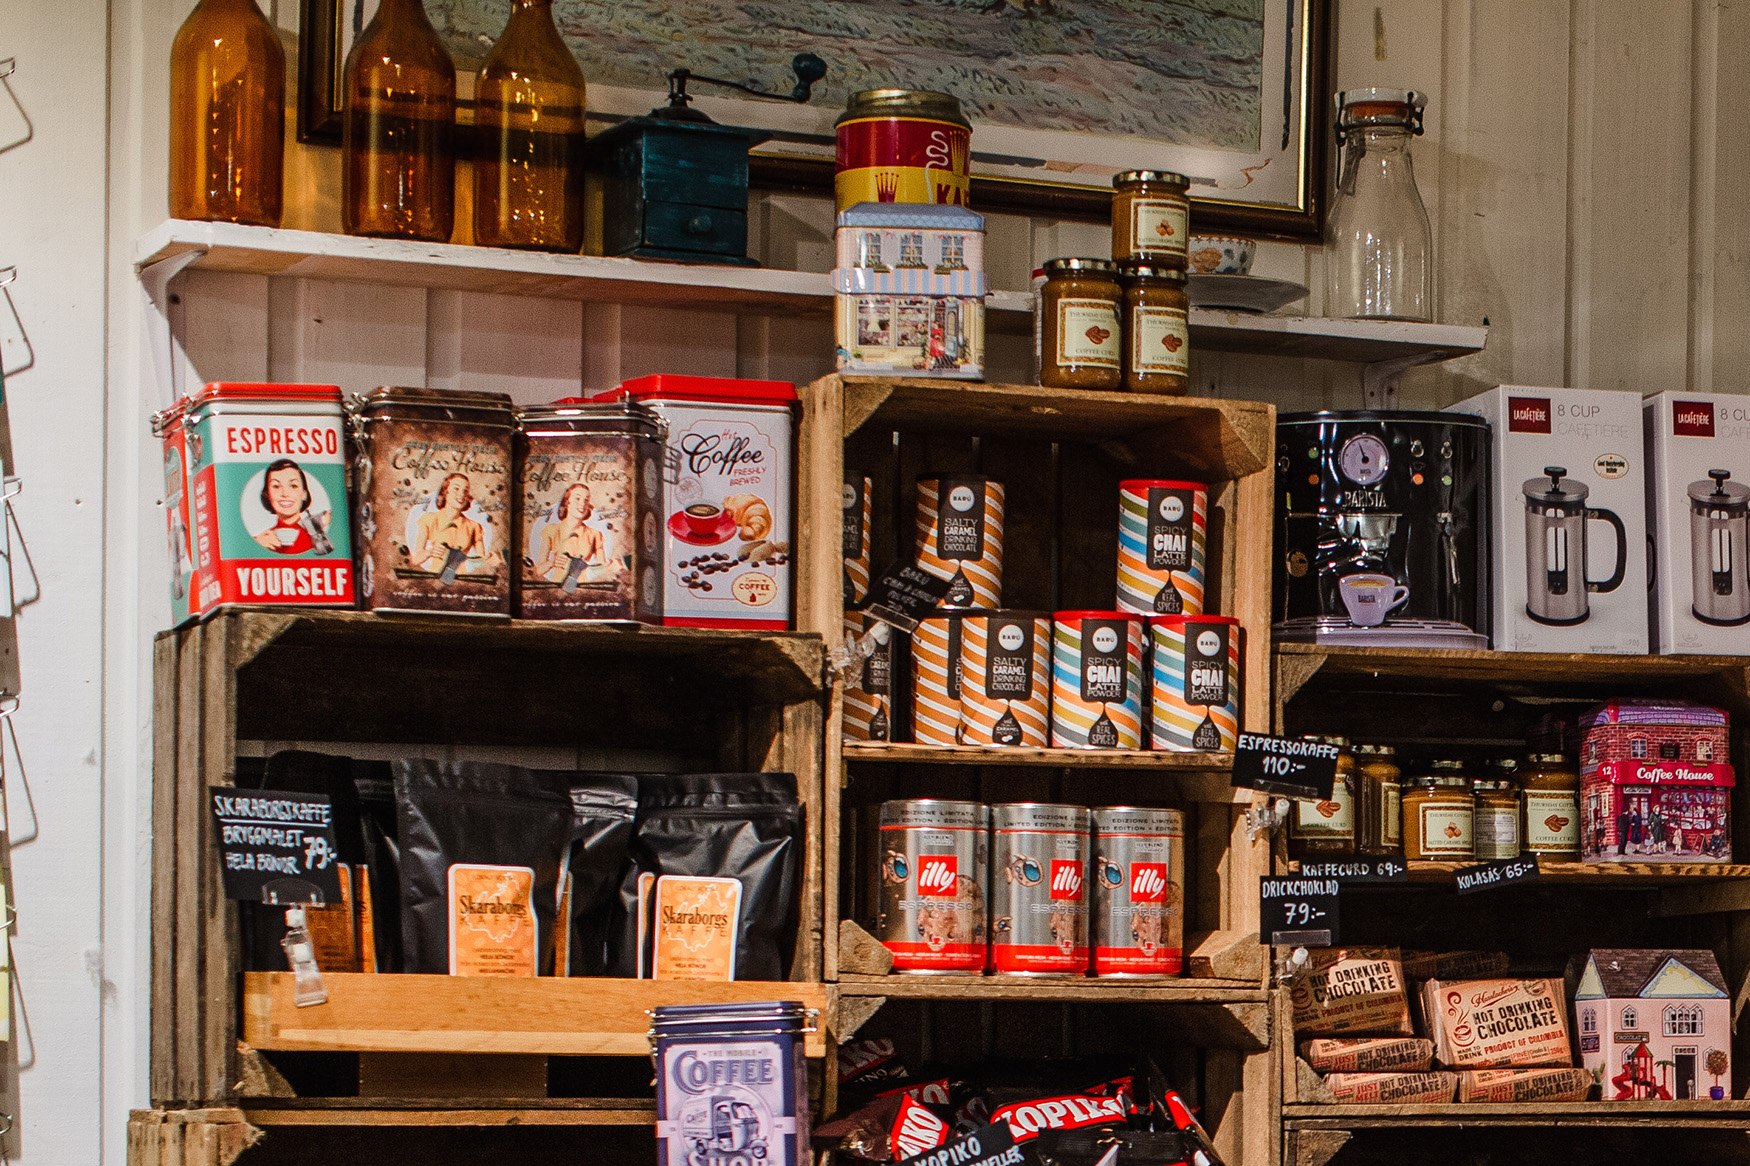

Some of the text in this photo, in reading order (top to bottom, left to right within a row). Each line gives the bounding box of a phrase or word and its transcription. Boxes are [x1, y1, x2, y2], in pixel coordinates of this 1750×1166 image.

[1557, 404, 1600, 419] 8 CUP
[1720, 408, 1729, 421] 8
[227, 427, 338, 455] ESPRESSO
[681, 433, 764, 478] Coffee
[392, 446, 448, 480] Coffee
[571, 462, 627, 483] House
[734, 466, 767, 477] FRESHLY
[729, 477, 761, 487] BREWED
[1342, 490, 1388, 508] BARISTA
[944, 518, 978, 528] SALTY
[1154, 525, 1187, 534] SPICY
[943, 527, 977, 537] CARAMEL
[943, 536, 977, 544] DRINKING
[1153, 534, 1187, 551] CHAI
[943, 544, 977, 552] CHOCOLATE
[1154, 551, 1187, 560] LATTE
[236, 567, 347, 597] YOURSELF
[738, 583, 770, 591] COFFEE
[1156, 602, 1180, 612] SPICES
[993, 657, 1027, 666] SALTY
[1087, 657, 1122, 666] SPICY
[1191, 660, 1224, 670] SPICY
[992, 666, 1027, 676] CARAMEL
[1086, 665, 1121, 684] CHAI
[1190, 669, 1224, 687] CHAI
[992, 675, 1026, 683] DRINKING
[992, 683, 1026, 692] CHOCOLATE
[1087, 683, 1121, 691] LATTE
[1087, 690, 1121, 698] POWDER
[1192, 686, 1224, 694] LATTE
[1191, 693, 1224, 701] POWDER
[1091, 734, 1116, 745] SPICES
[1195, 737, 1219, 748] SPICES
[1238, 734, 1340, 760] ESPRESSOKAFFE
[1262, 755, 1306, 776] 110:-
[1602, 766, 1612, 776] 12
[1636, 767, 1715, 783] Coffee House
[214, 795, 332, 823] SKARABORGSKAFFE
[919, 860, 957, 893] illy
[1302, 863, 1370, 877] KAFFECURD
[1052, 865, 1082, 897] illy
[1133, 868, 1166, 899] illy
[1262, 880, 1339, 898] DRICKCHOKLAD
[459, 895, 526, 916] Skaraborgs
[899, 900, 974, 911] ESPRESSO
[662, 906, 728, 926] Skaraborgs
[1309, 961, 1391, 988] HOT DRINKING
[1314, 975, 1397, 1003] CHOCOLATE
[1472, 996, 1553, 1025] HOT DRINKING
[1477, 1010, 1558, 1040] CHOCOLATE
[1484, 1029, 1565, 1056] PRODUCT OF COLOMBIA
[1334, 1054, 1356, 1065] JUST
[1458, 1051, 1483, 1062] DRINK
[673, 1050, 773, 1095] COFFEE
[1357, 1082, 1378, 1093] JUST
[1379, 1079, 1395, 1090] HOT
[1380, 1081, 1441, 1101] CHOCOLATE
[1491, 1084, 1513, 1094] JUST
